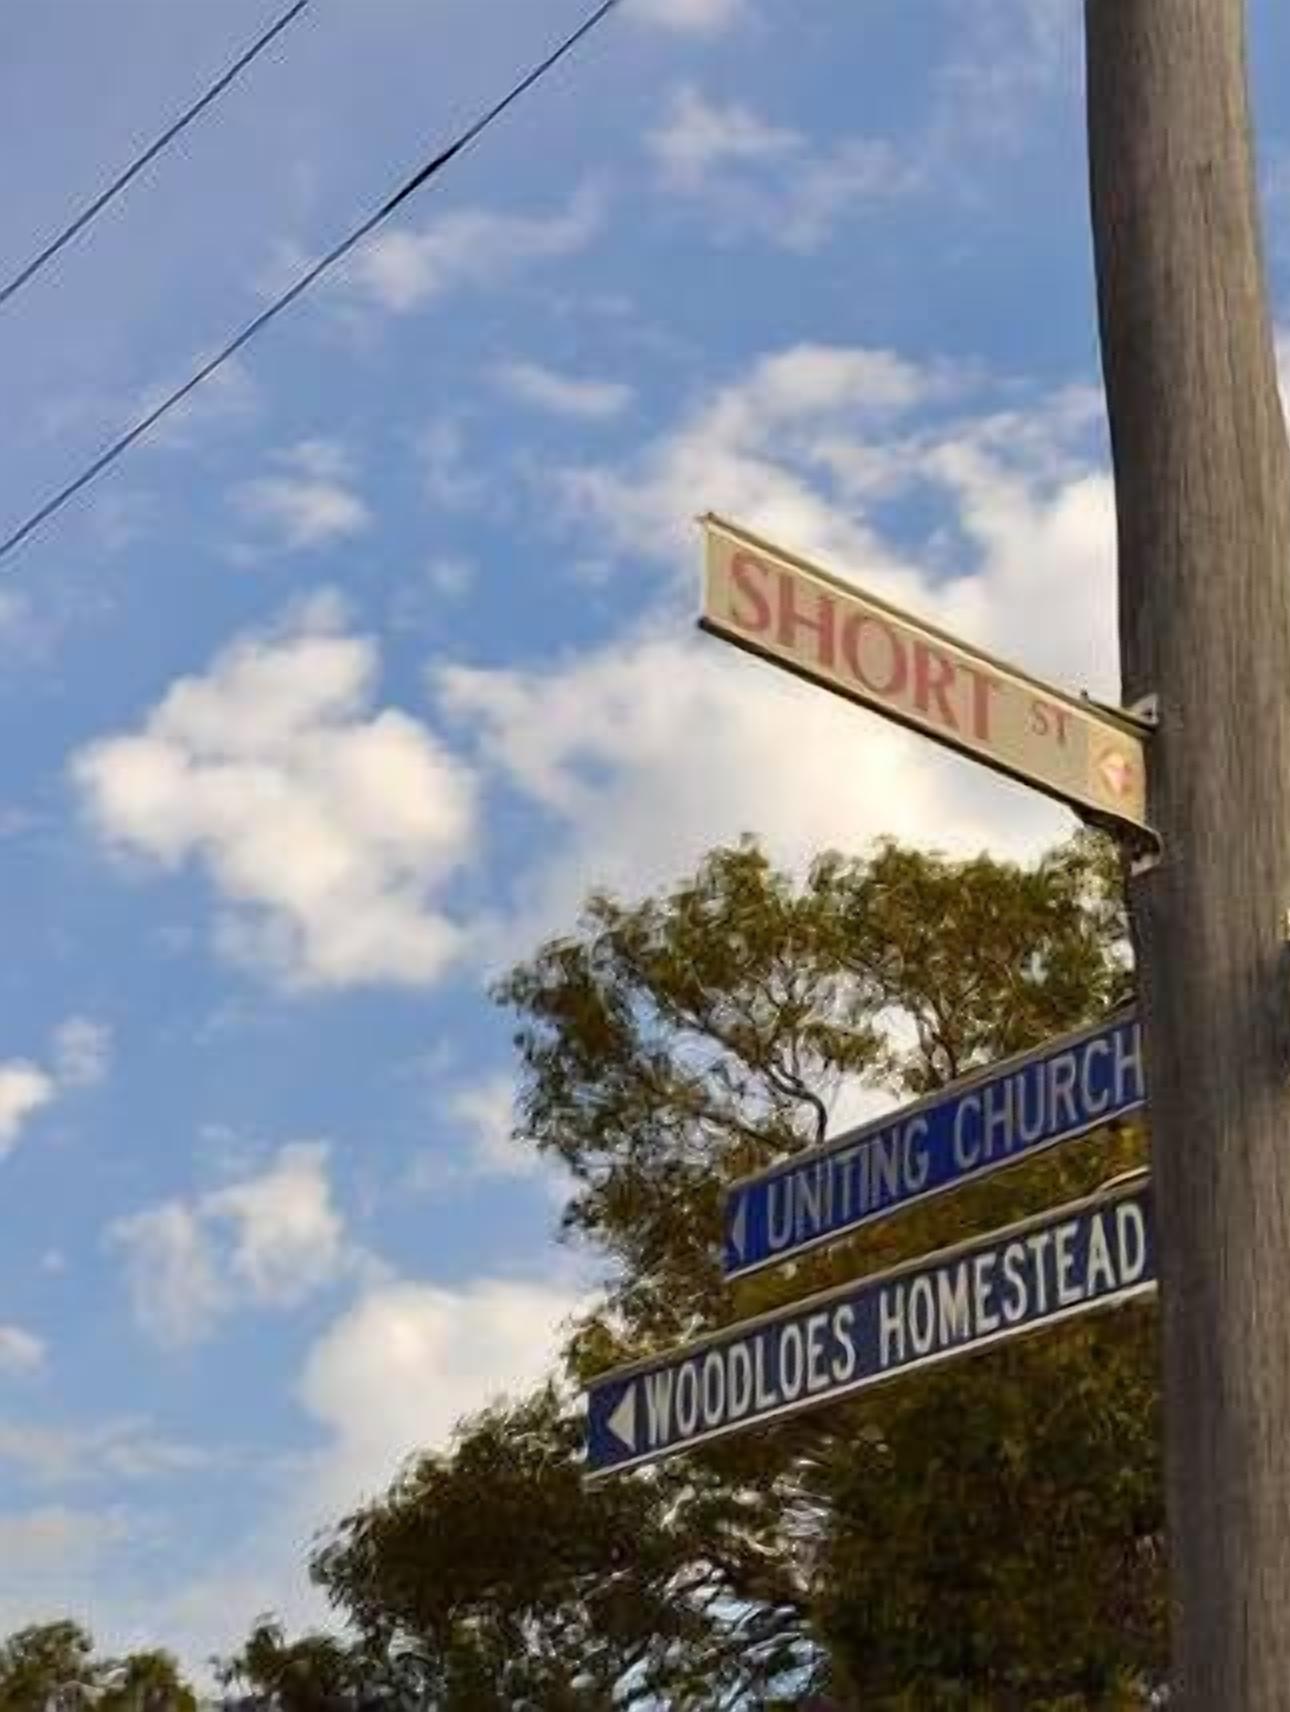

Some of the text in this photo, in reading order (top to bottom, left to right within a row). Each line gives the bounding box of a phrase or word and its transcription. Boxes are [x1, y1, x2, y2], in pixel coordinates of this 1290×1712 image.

[728, 551, 1073, 743] SHORT ST
[767, 1024, 1145, 1249] UNITING CHURCH
[643, 1201, 1146, 1447] WOODLOES HOMESTEAD
